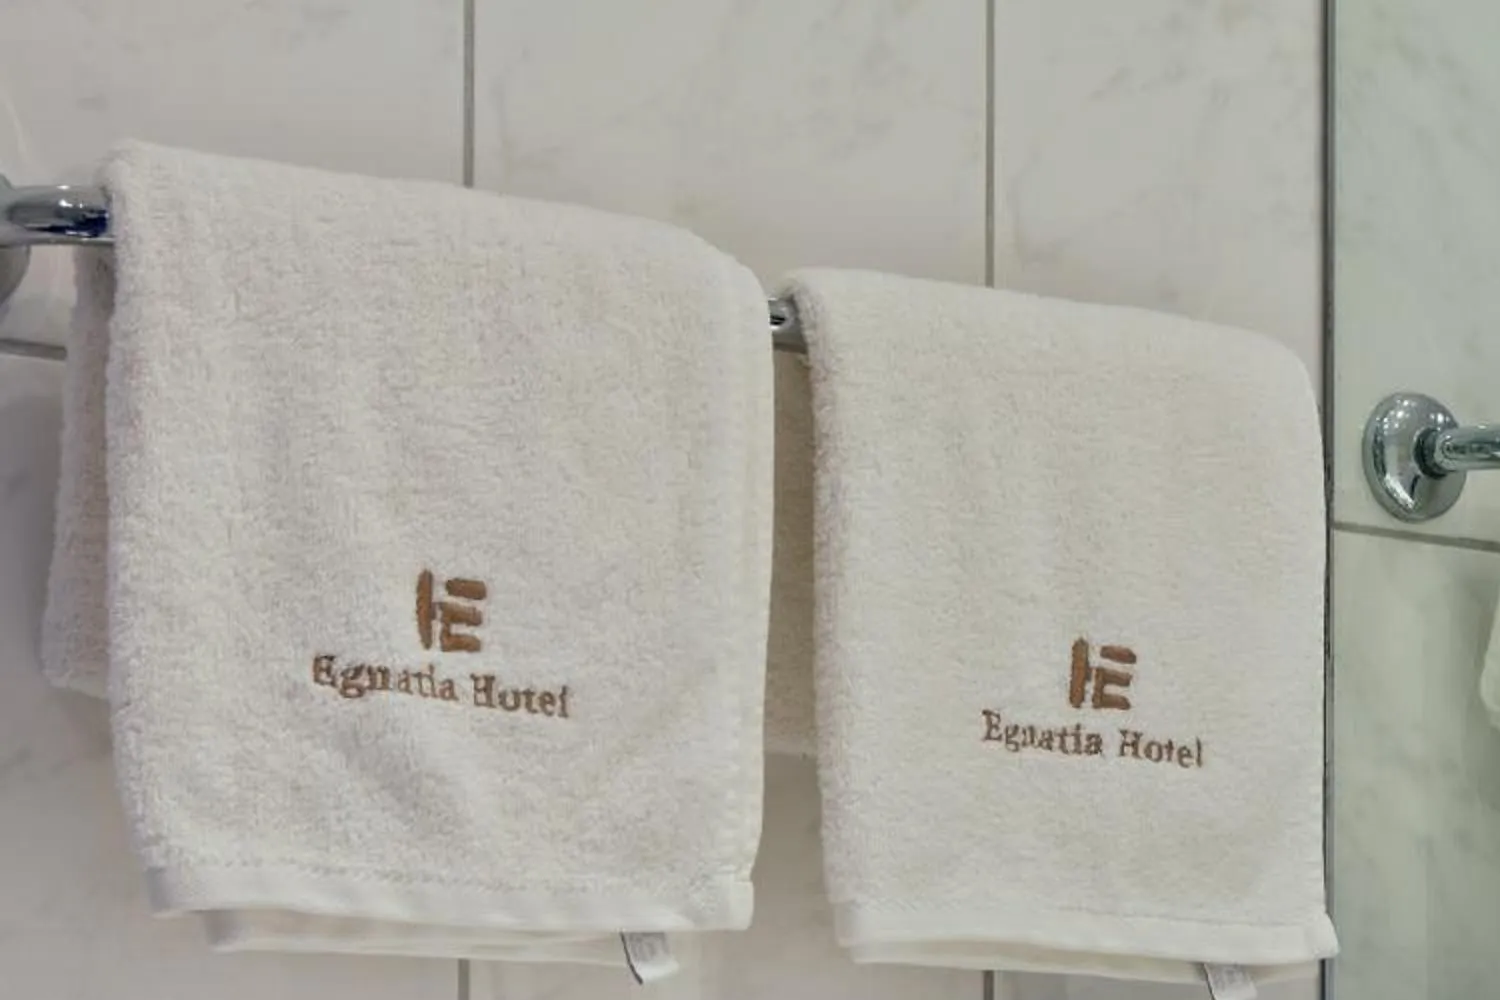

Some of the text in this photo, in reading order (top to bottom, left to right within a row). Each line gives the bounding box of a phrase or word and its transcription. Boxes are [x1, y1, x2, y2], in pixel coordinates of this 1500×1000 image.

[312, 654, 459, 700] Egnatia
[982, 709, 1203, 768] Egnatia Hotel
